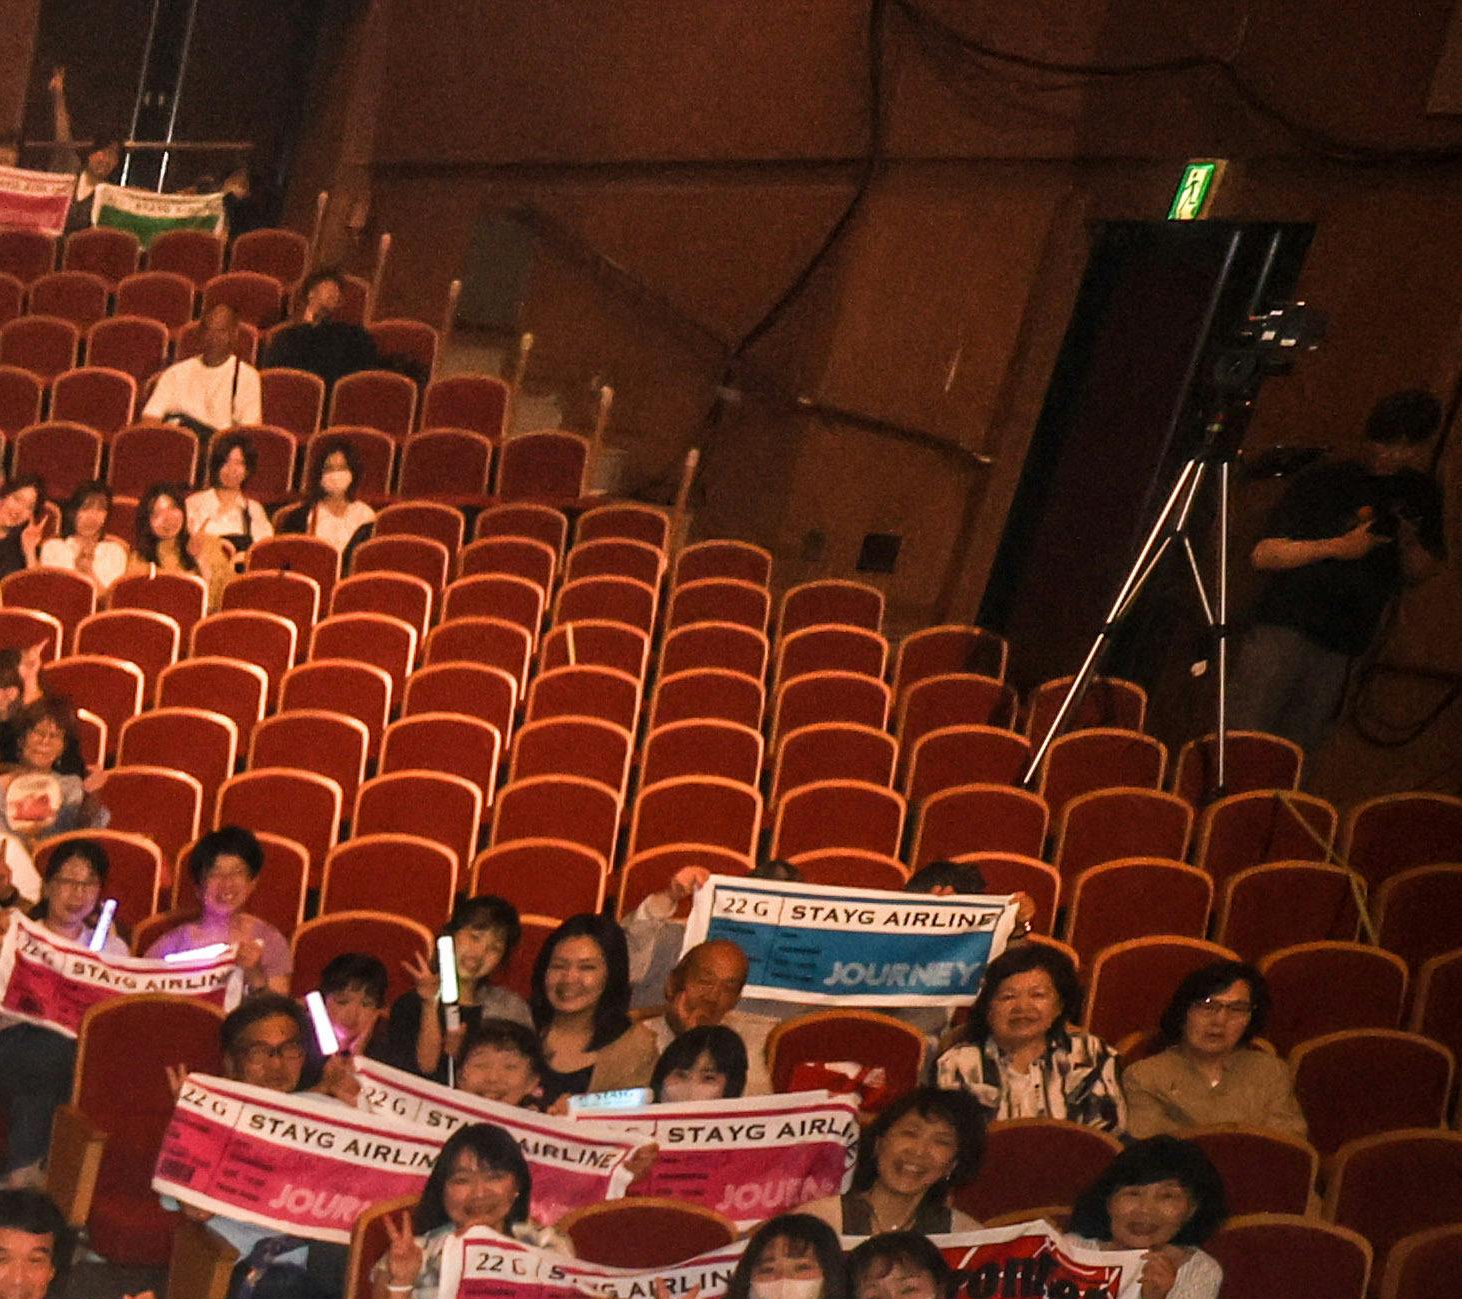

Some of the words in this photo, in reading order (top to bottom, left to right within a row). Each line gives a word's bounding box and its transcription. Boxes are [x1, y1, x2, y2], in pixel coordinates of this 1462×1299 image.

[723, 896, 746, 914] 22
[753, 898, 769, 916] G
[791, 906, 876, 926] STAYG
[884, 911, 999, 931] AIRLINE
[823, 961, 982, 988] JOURNEY
[249, 1114, 335, 1151] STAYG
